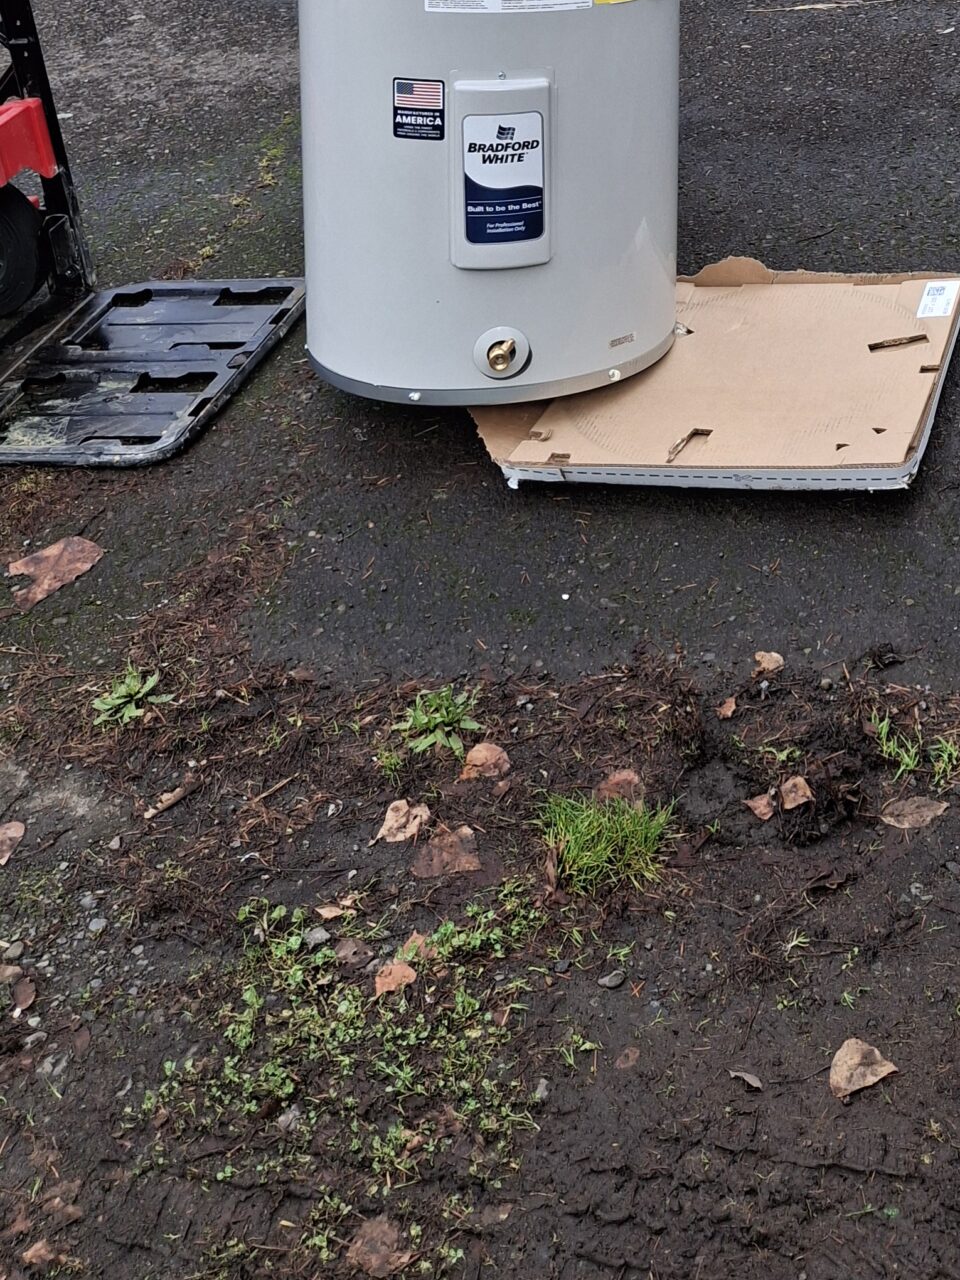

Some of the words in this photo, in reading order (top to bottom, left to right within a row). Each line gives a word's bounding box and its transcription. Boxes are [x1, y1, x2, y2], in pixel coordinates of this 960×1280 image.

[395, 114, 442, 126] AMERICA
[467, 139, 540, 153] BRADFORD
[482, 152, 525, 164] WHITE
[522, 201, 539, 209] Best
